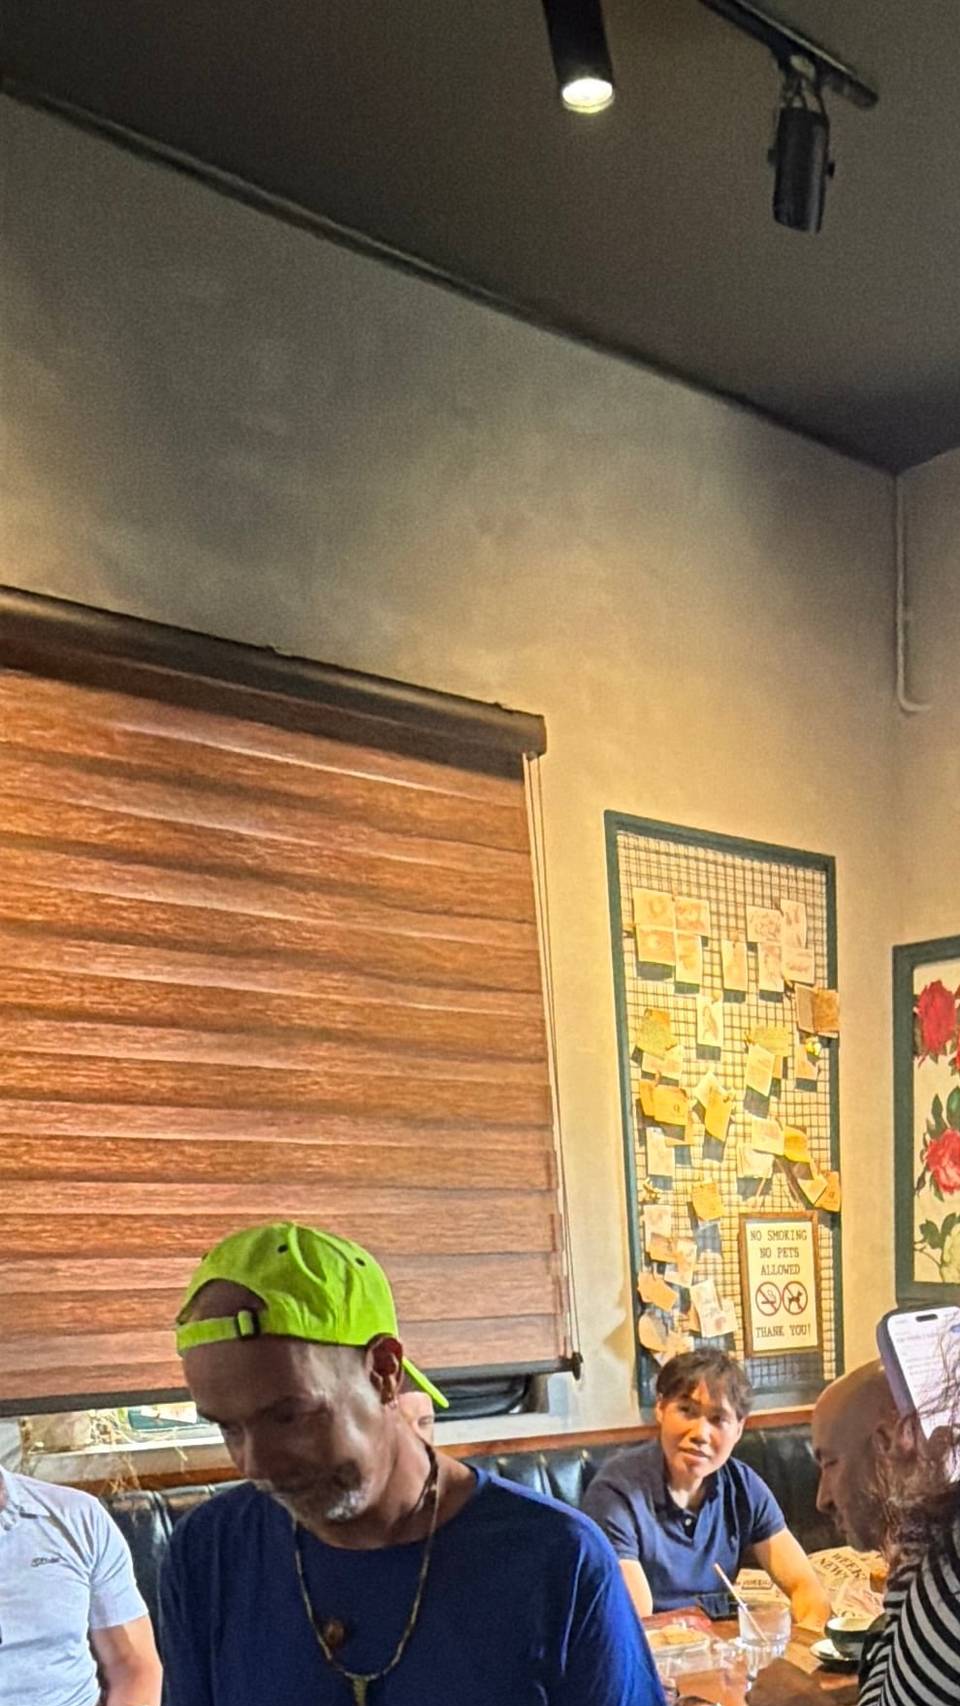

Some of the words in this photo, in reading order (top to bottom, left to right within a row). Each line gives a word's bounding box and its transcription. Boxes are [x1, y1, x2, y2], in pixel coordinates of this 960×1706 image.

[750, 1230, 762, 1241] NO
[767, 1230, 808, 1241] SMOKING
[760, 1248, 772, 1259] NO
[777, 1247, 800, 1259] PETS
[760, 1264, 801, 1276] ALLOWED
[756, 1326, 784, 1338] THANK
[790, 1324, 811, 1337] YOU!
